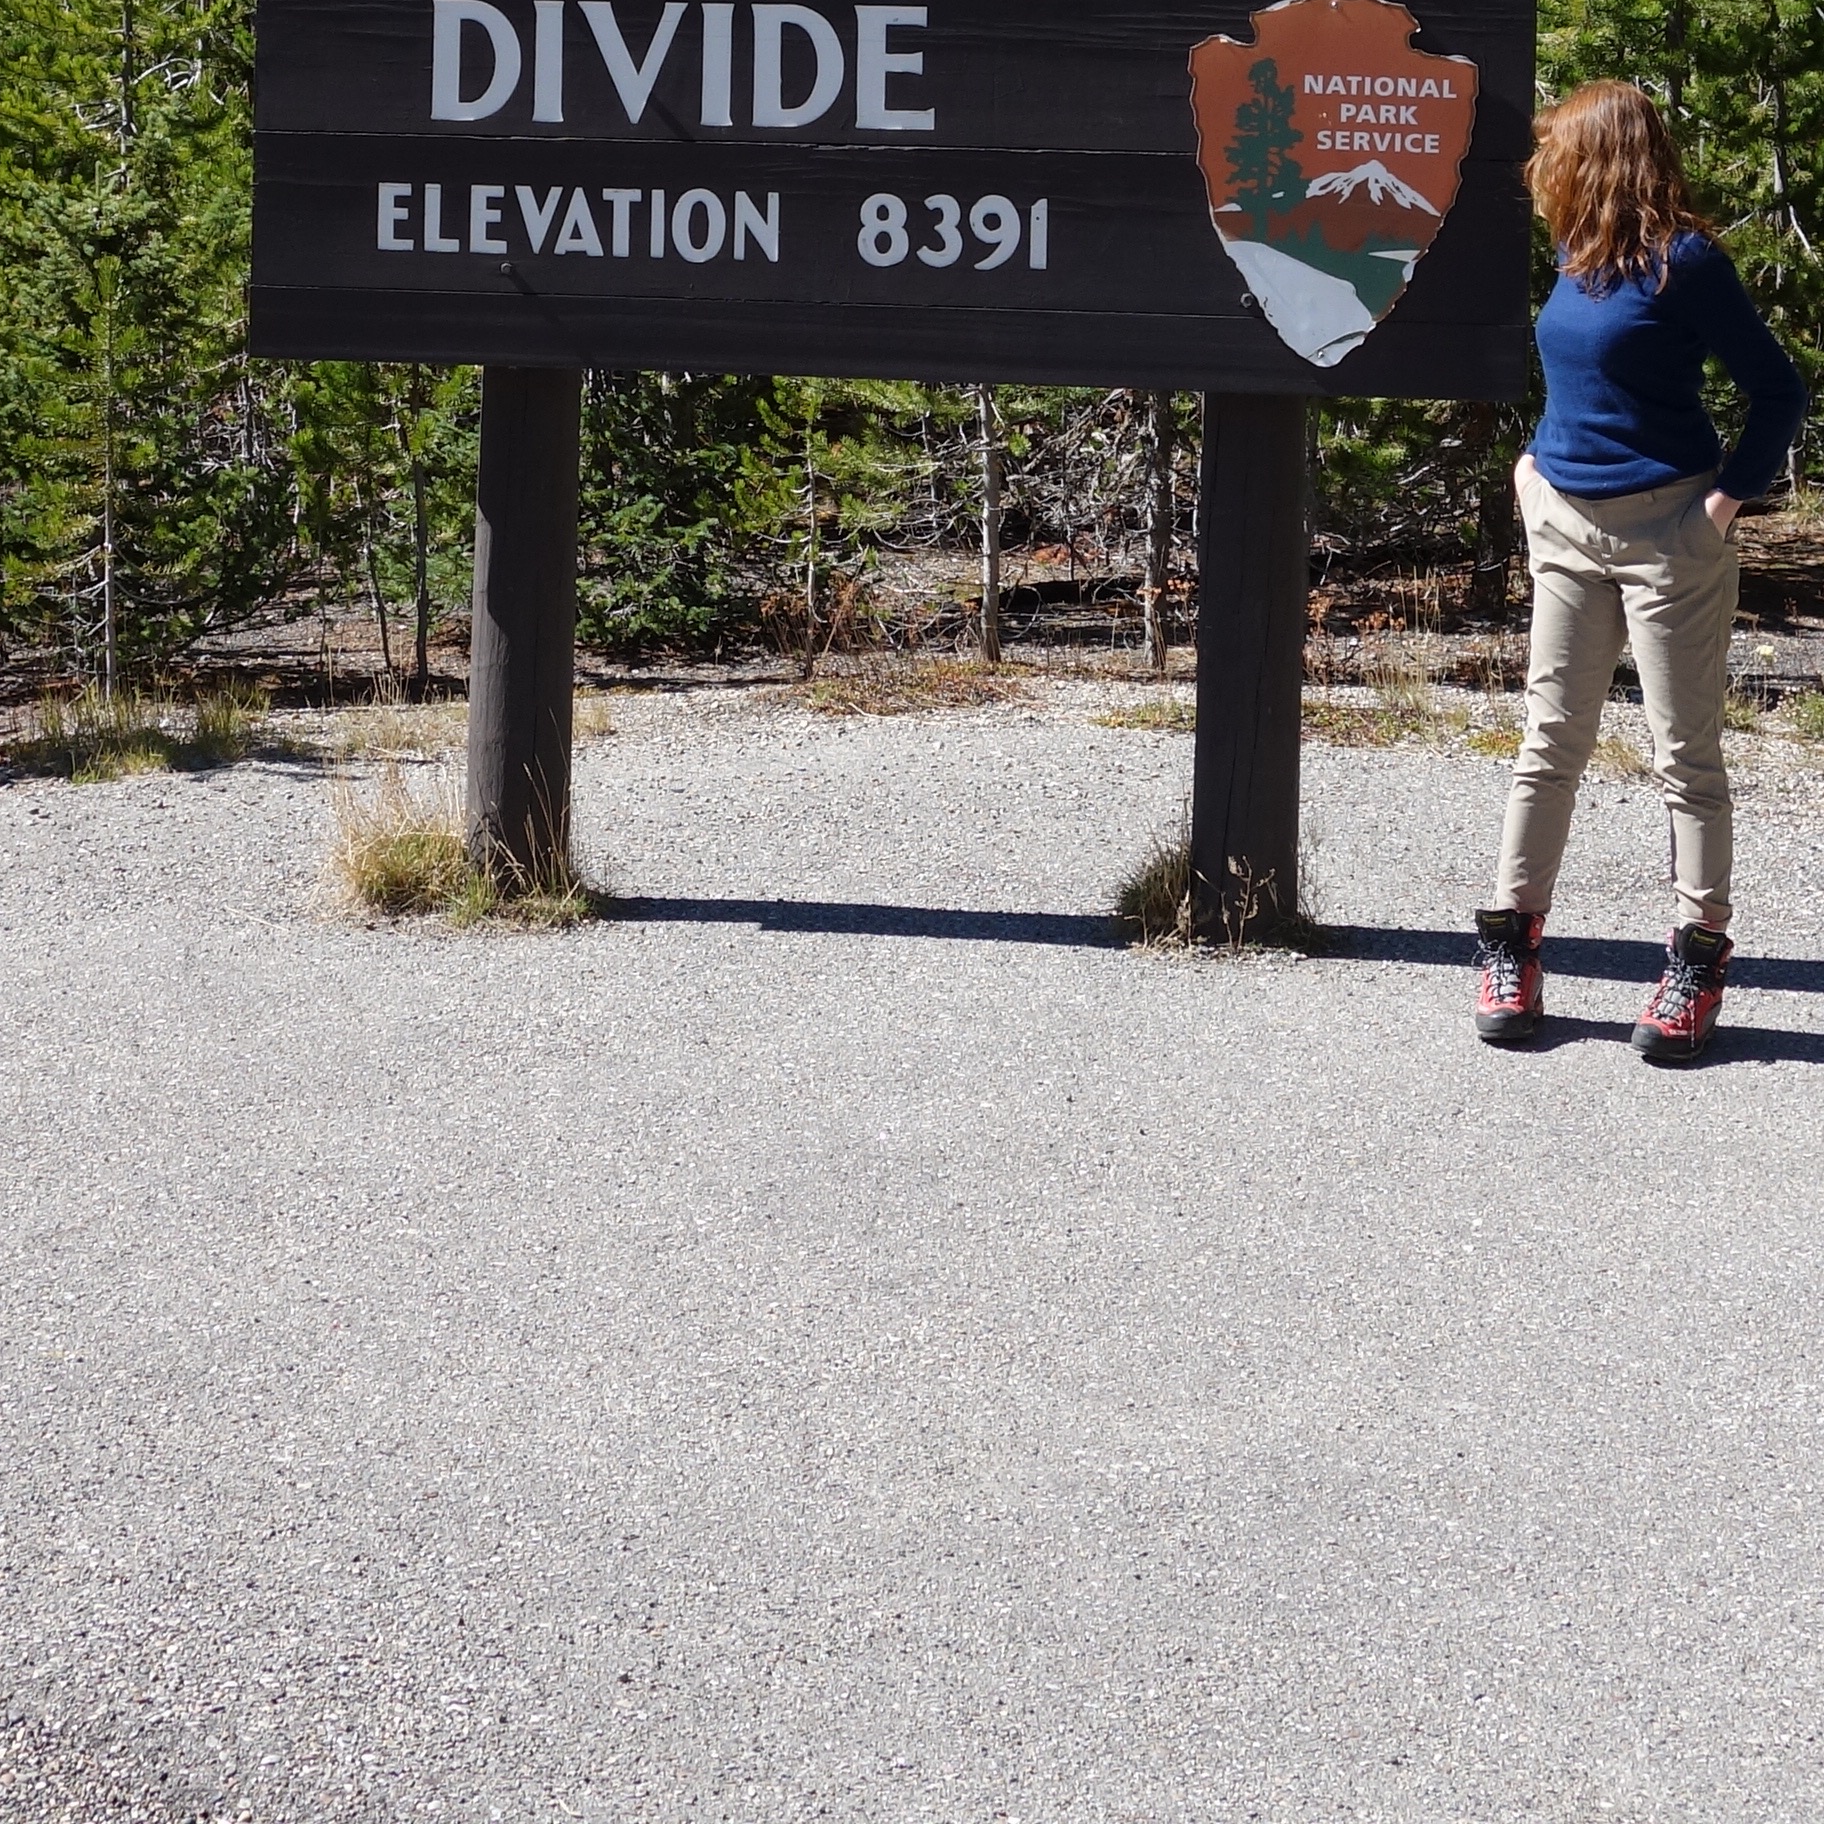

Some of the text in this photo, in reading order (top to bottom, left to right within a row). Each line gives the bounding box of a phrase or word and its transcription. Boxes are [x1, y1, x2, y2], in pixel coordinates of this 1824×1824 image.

[1303, 74, 1457, 99] NATIONAL
[1340, 103, 1418, 125] PARK
[1316, 130, 1440, 154] SERVICE
[377, 182, 1048, 271] ELEVATION 8391
